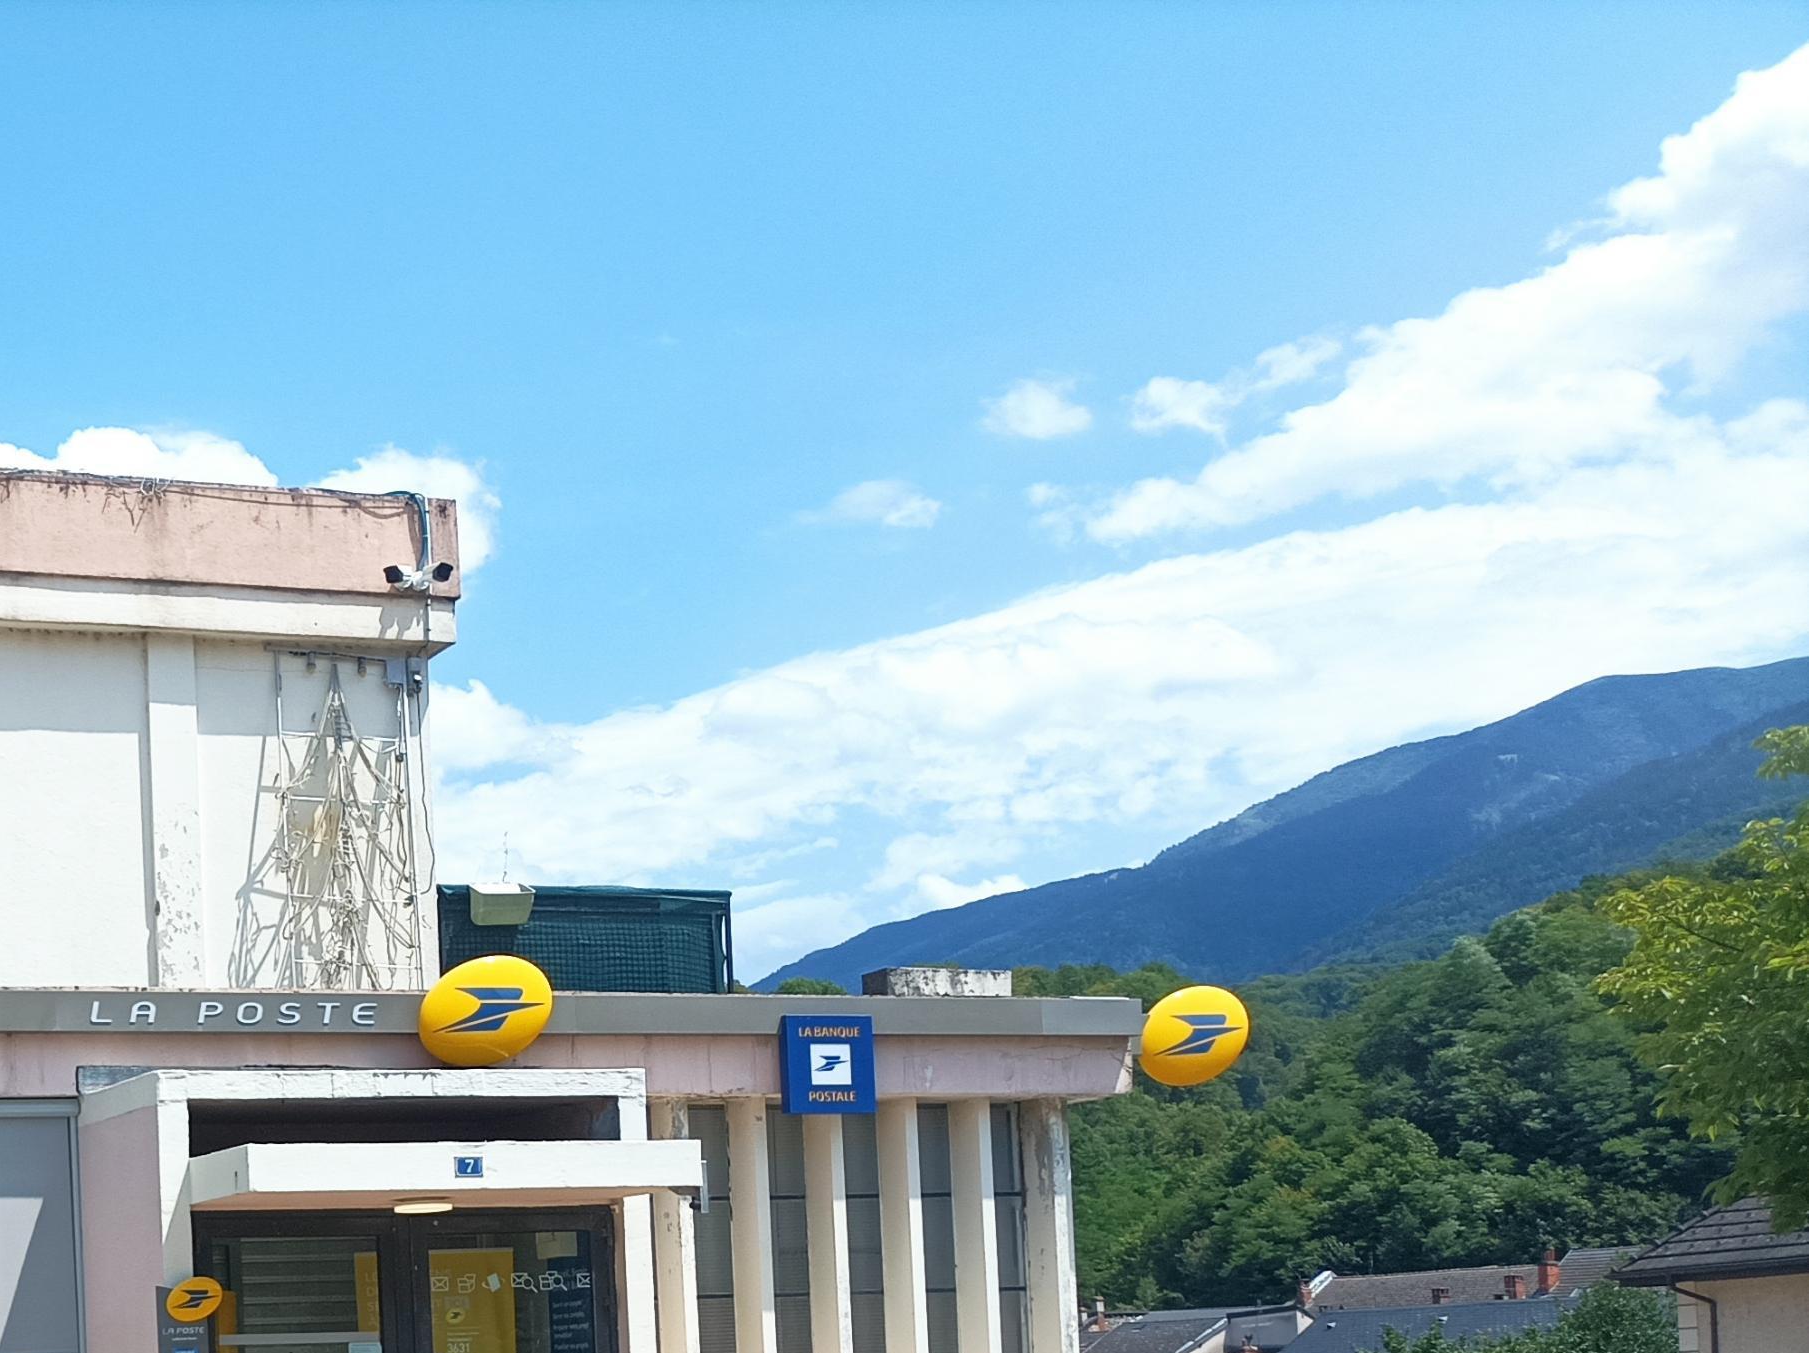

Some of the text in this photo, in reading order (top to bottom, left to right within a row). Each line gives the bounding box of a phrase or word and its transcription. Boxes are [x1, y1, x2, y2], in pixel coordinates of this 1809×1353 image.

[89, 1000, 380, 1026] LA POSTE
[798, 1025, 861, 1039] LA BANQUE
[807, 1090, 857, 1103] POSTALE
[464, 1158, 475, 1173] 7
[162, 1326, 206, 1336] LA POSTE
[446, 1342, 471, 1353] 3631
